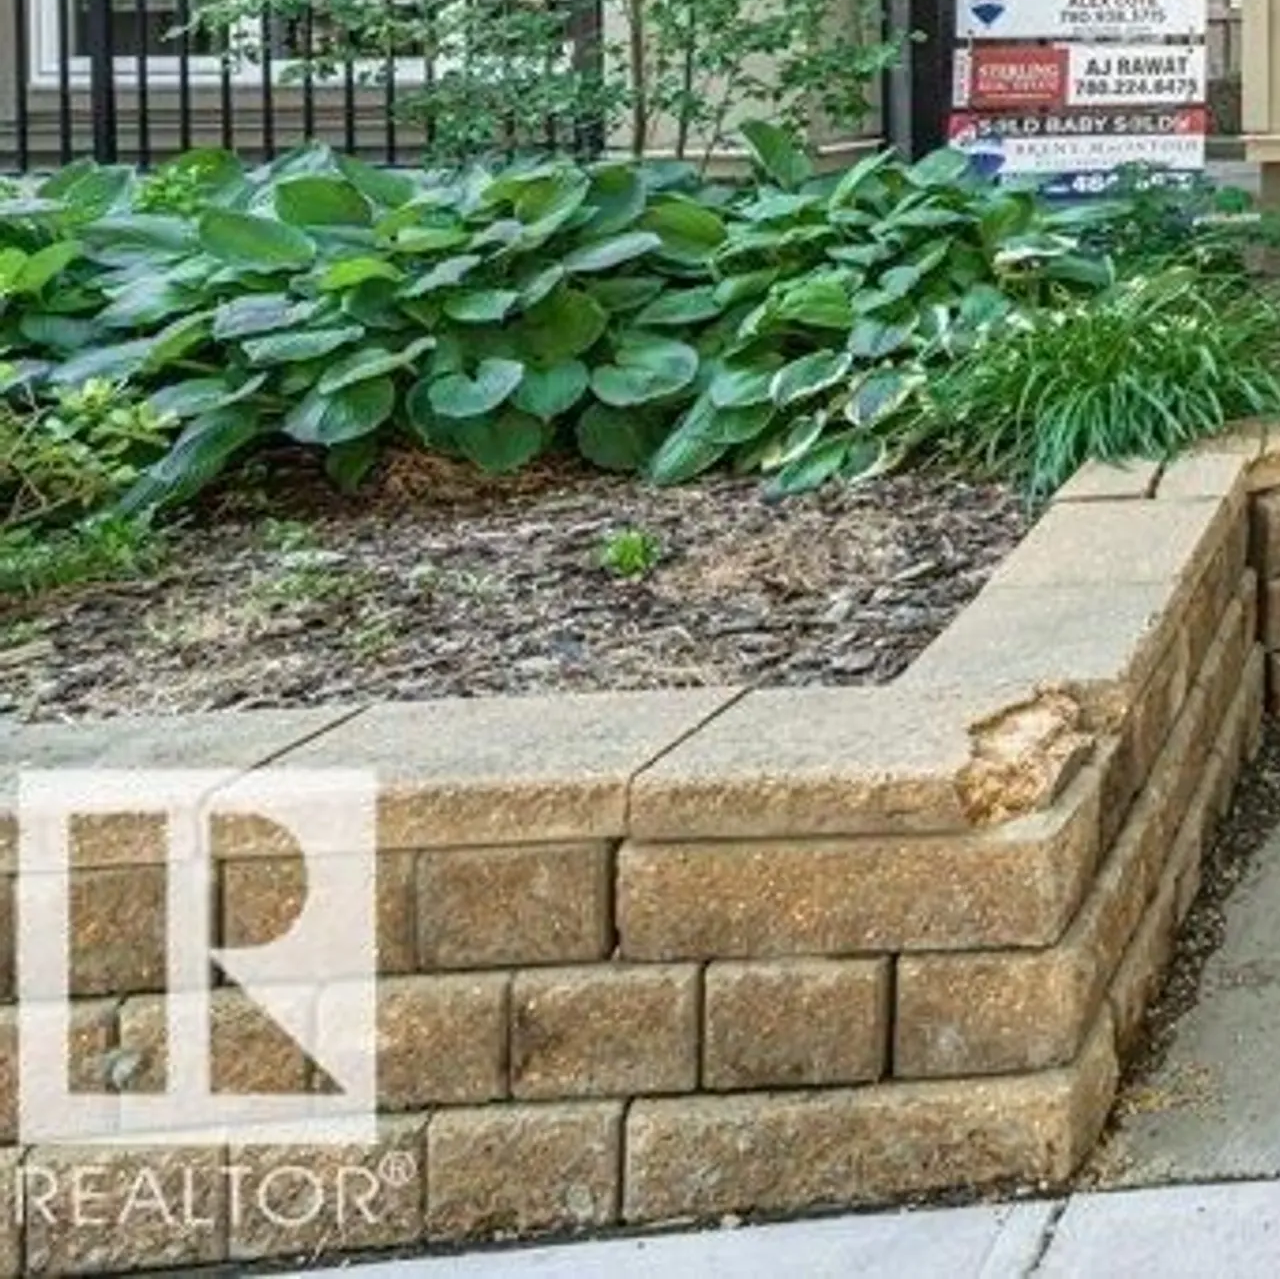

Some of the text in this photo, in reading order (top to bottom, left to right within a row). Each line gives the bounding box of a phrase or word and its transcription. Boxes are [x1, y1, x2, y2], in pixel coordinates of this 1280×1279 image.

[978, 63, 1060, 80] STERLING
[1084, 56, 1189, 75] AJ RAWAT
[1045, 115, 1108, 132] BABY
[1113, 114, 1174, 132] SOLD
